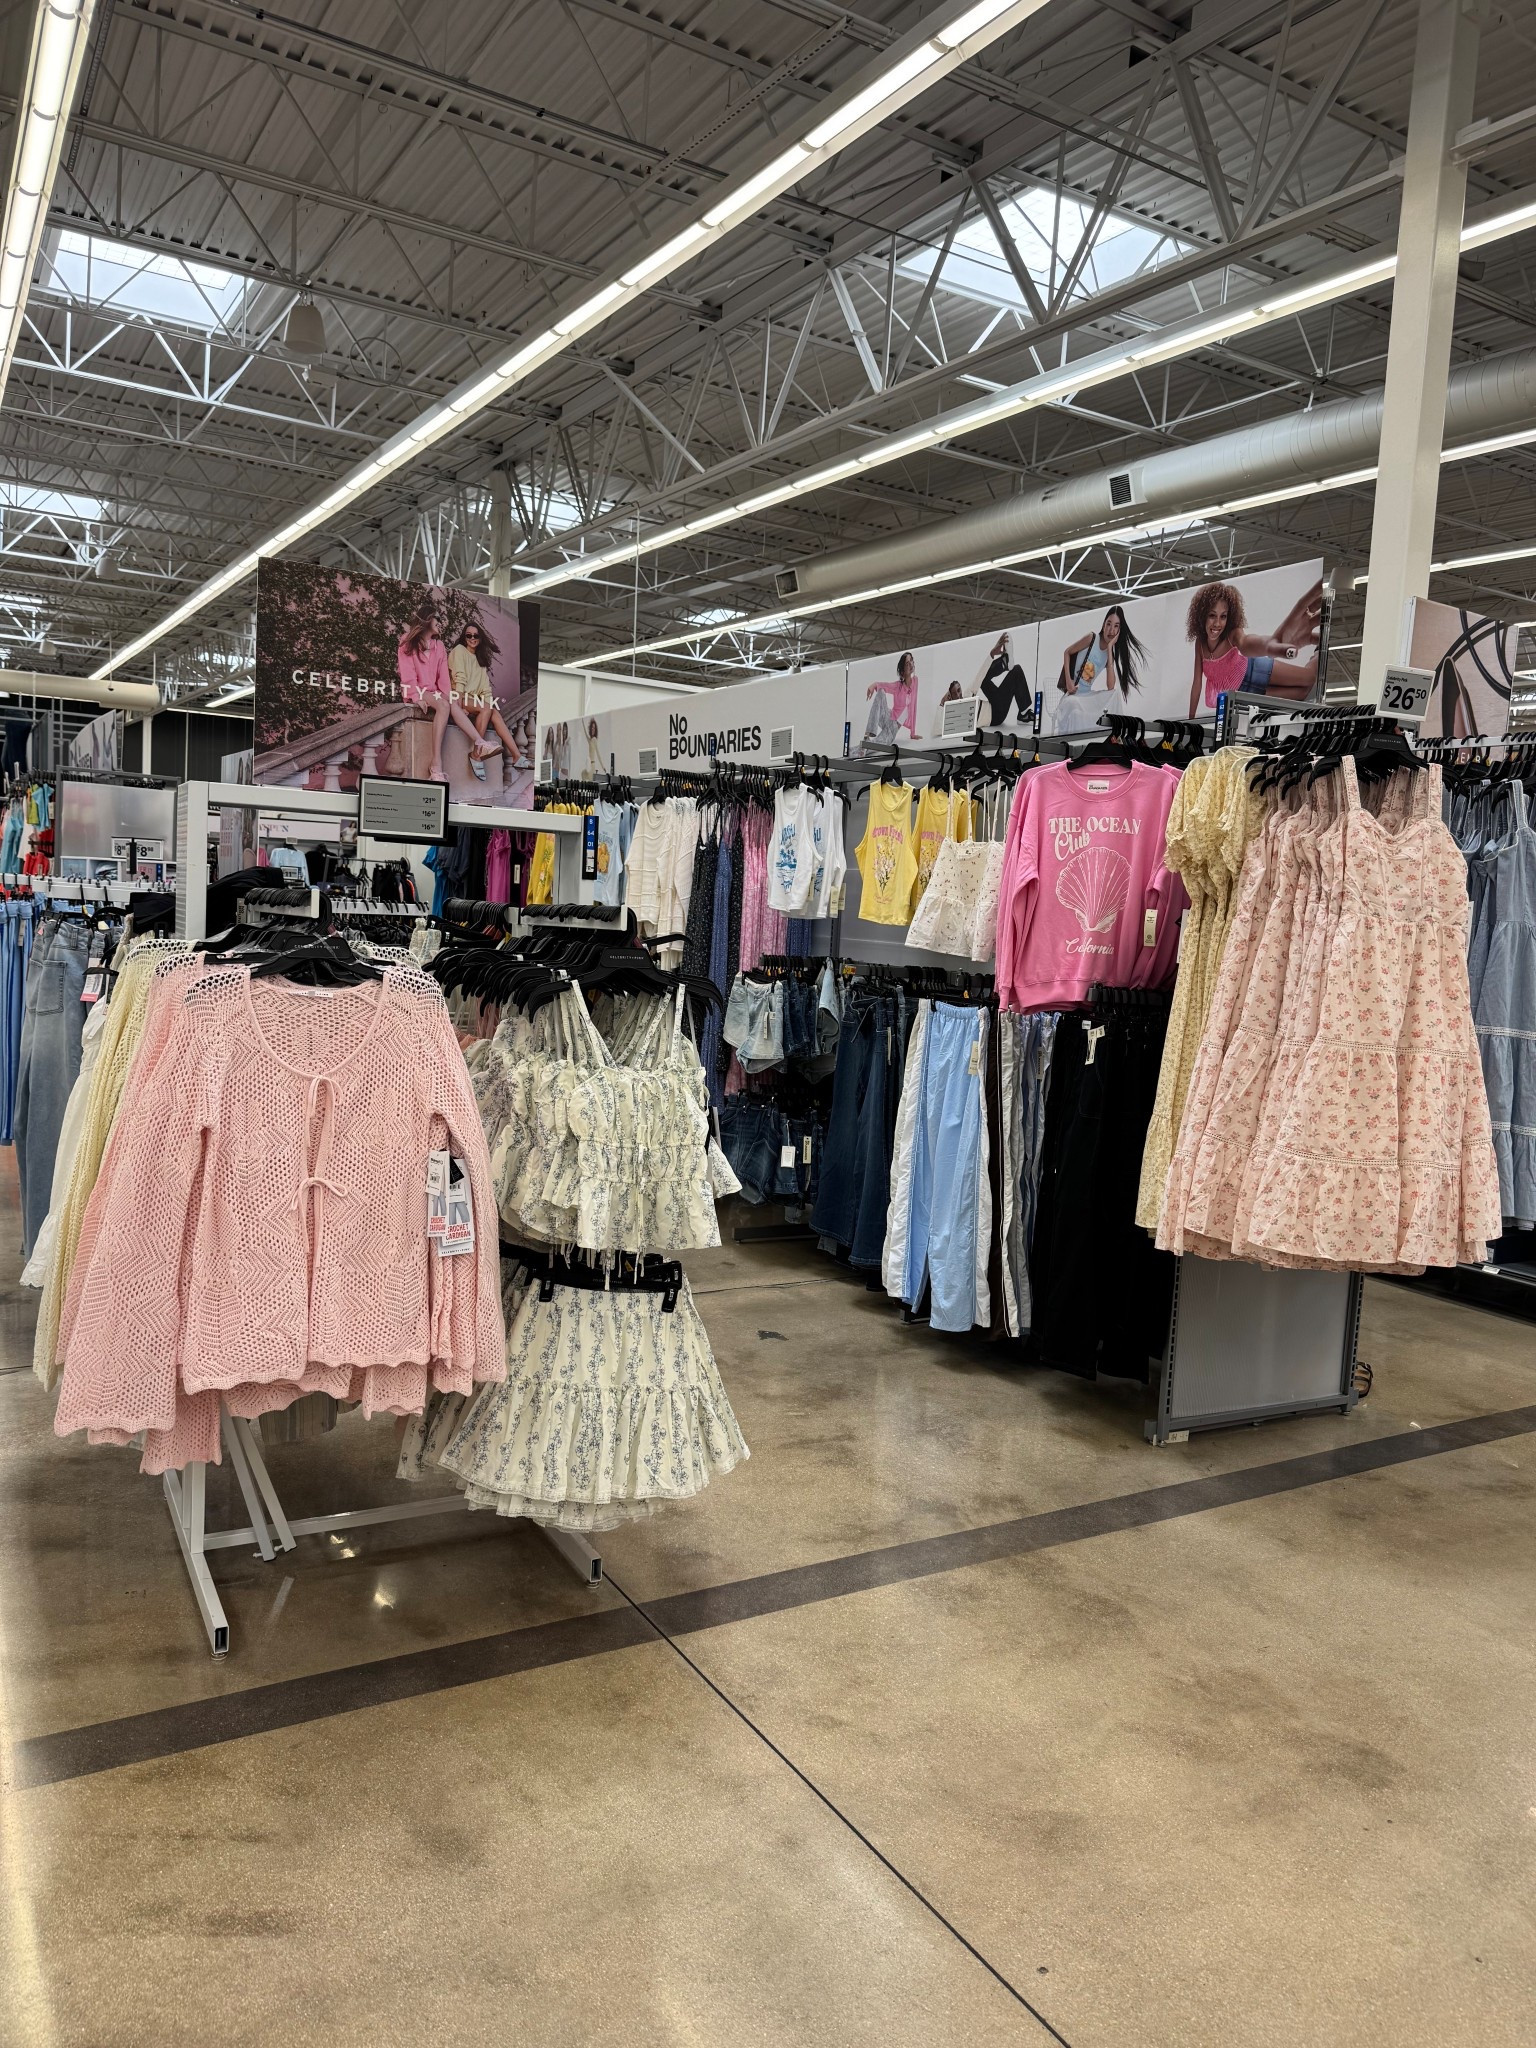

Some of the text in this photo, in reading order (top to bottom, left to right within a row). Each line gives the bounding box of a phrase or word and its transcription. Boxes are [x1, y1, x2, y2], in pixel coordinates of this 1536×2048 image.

[292, 669, 501, 711] CELEBRITY PINK
[1048, 816, 1142, 835] THE OCEAN
[1054, 828, 1091, 861] Club
